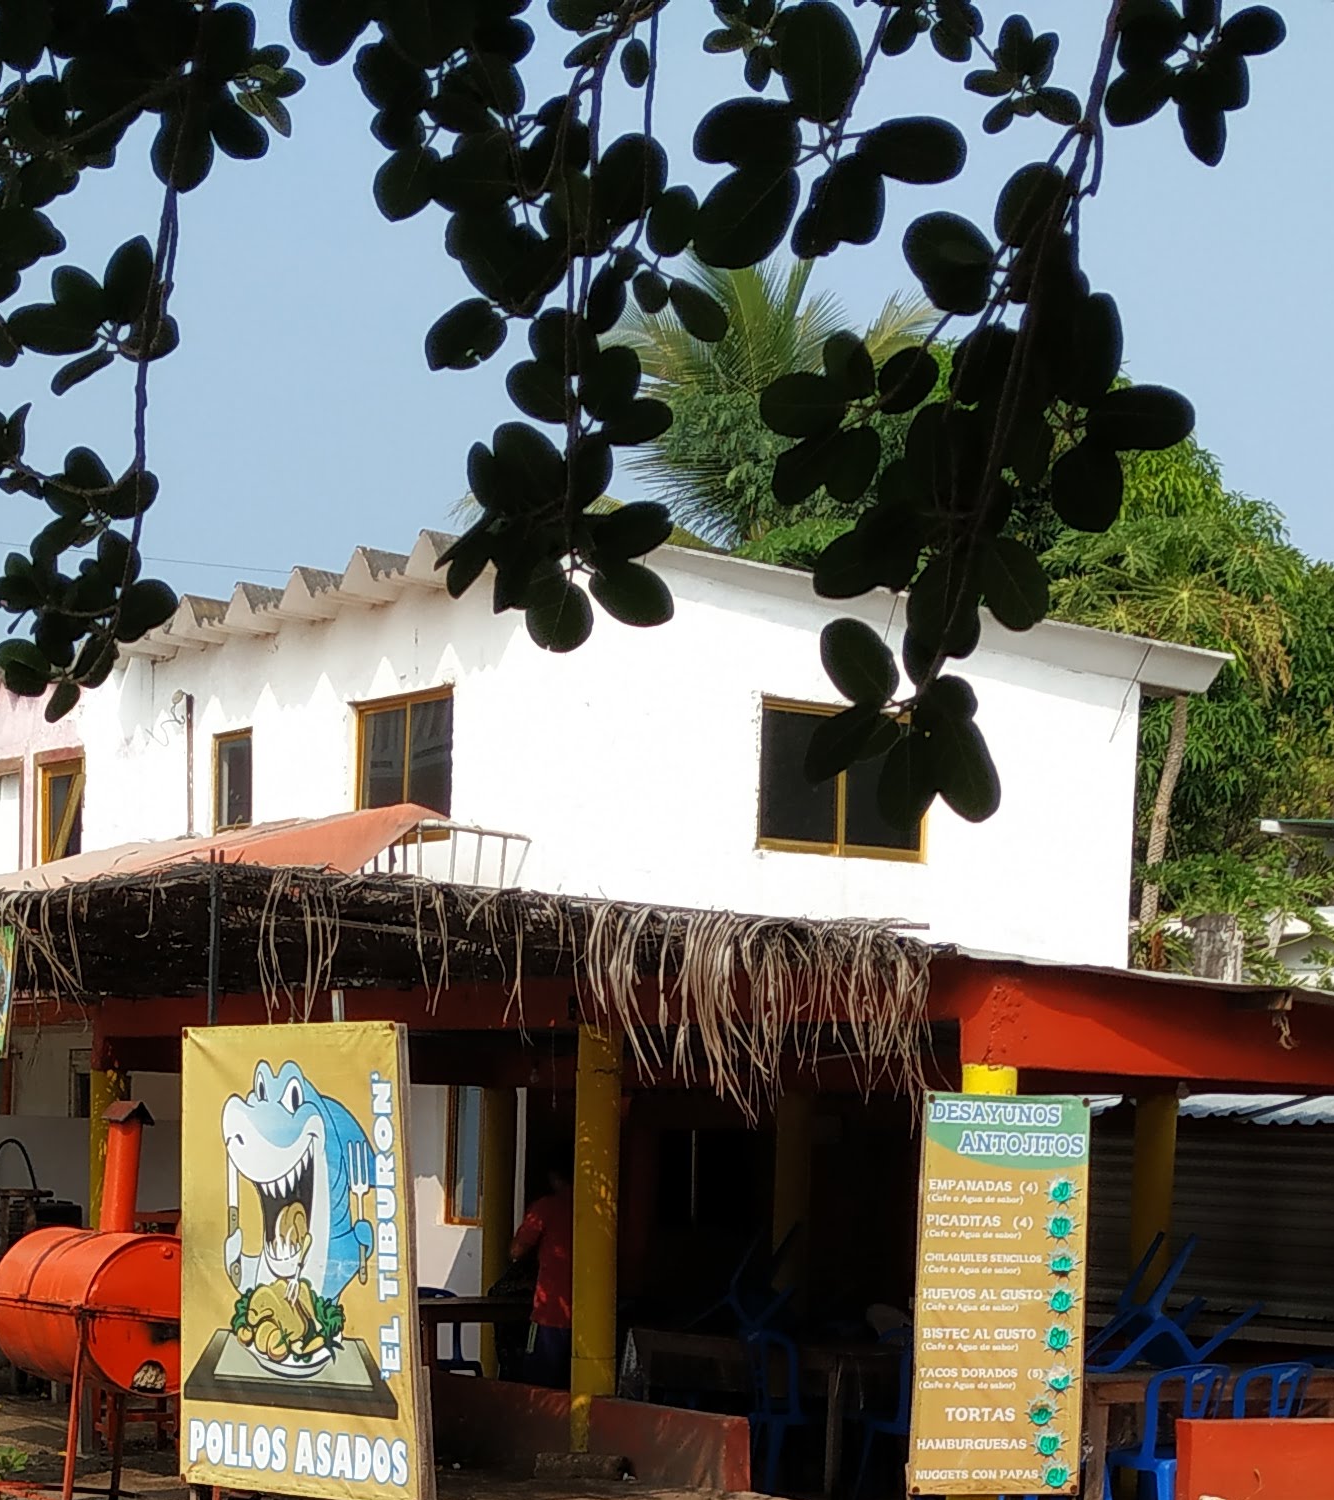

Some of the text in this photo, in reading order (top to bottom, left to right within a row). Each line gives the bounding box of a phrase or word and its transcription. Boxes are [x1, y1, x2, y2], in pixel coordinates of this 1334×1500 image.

[931, 1102, 1061, 1126] DESAYUNOS
[958, 1132, 1085, 1156] ANTOJITOS
[928, 1179, 1038, 1195] EMPANADAS (4)
[926, 1214, 1033, 1230] PICADITAS (4)
[924, 1253, 988, 1263] CHILAQUILES
[990, 1253, 1042, 1264] SENCILLOS
[922, 1288, 1043, 1300] HUEVOS AL GUSTO
[922, 1328, 1036, 1340] BISTEC AL GUSTO
[920, 1368, 1044, 1380] TACOS DORADOS (5)
[945, 1407, 1016, 1422] TORTAS
[916, 1438, 1027, 1450] HAMBURGUESAS
[188, 1418, 409, 1487] POLLOS ASADOS
[915, 1469, 1039, 1481] NUGGETS CON PAPAS
